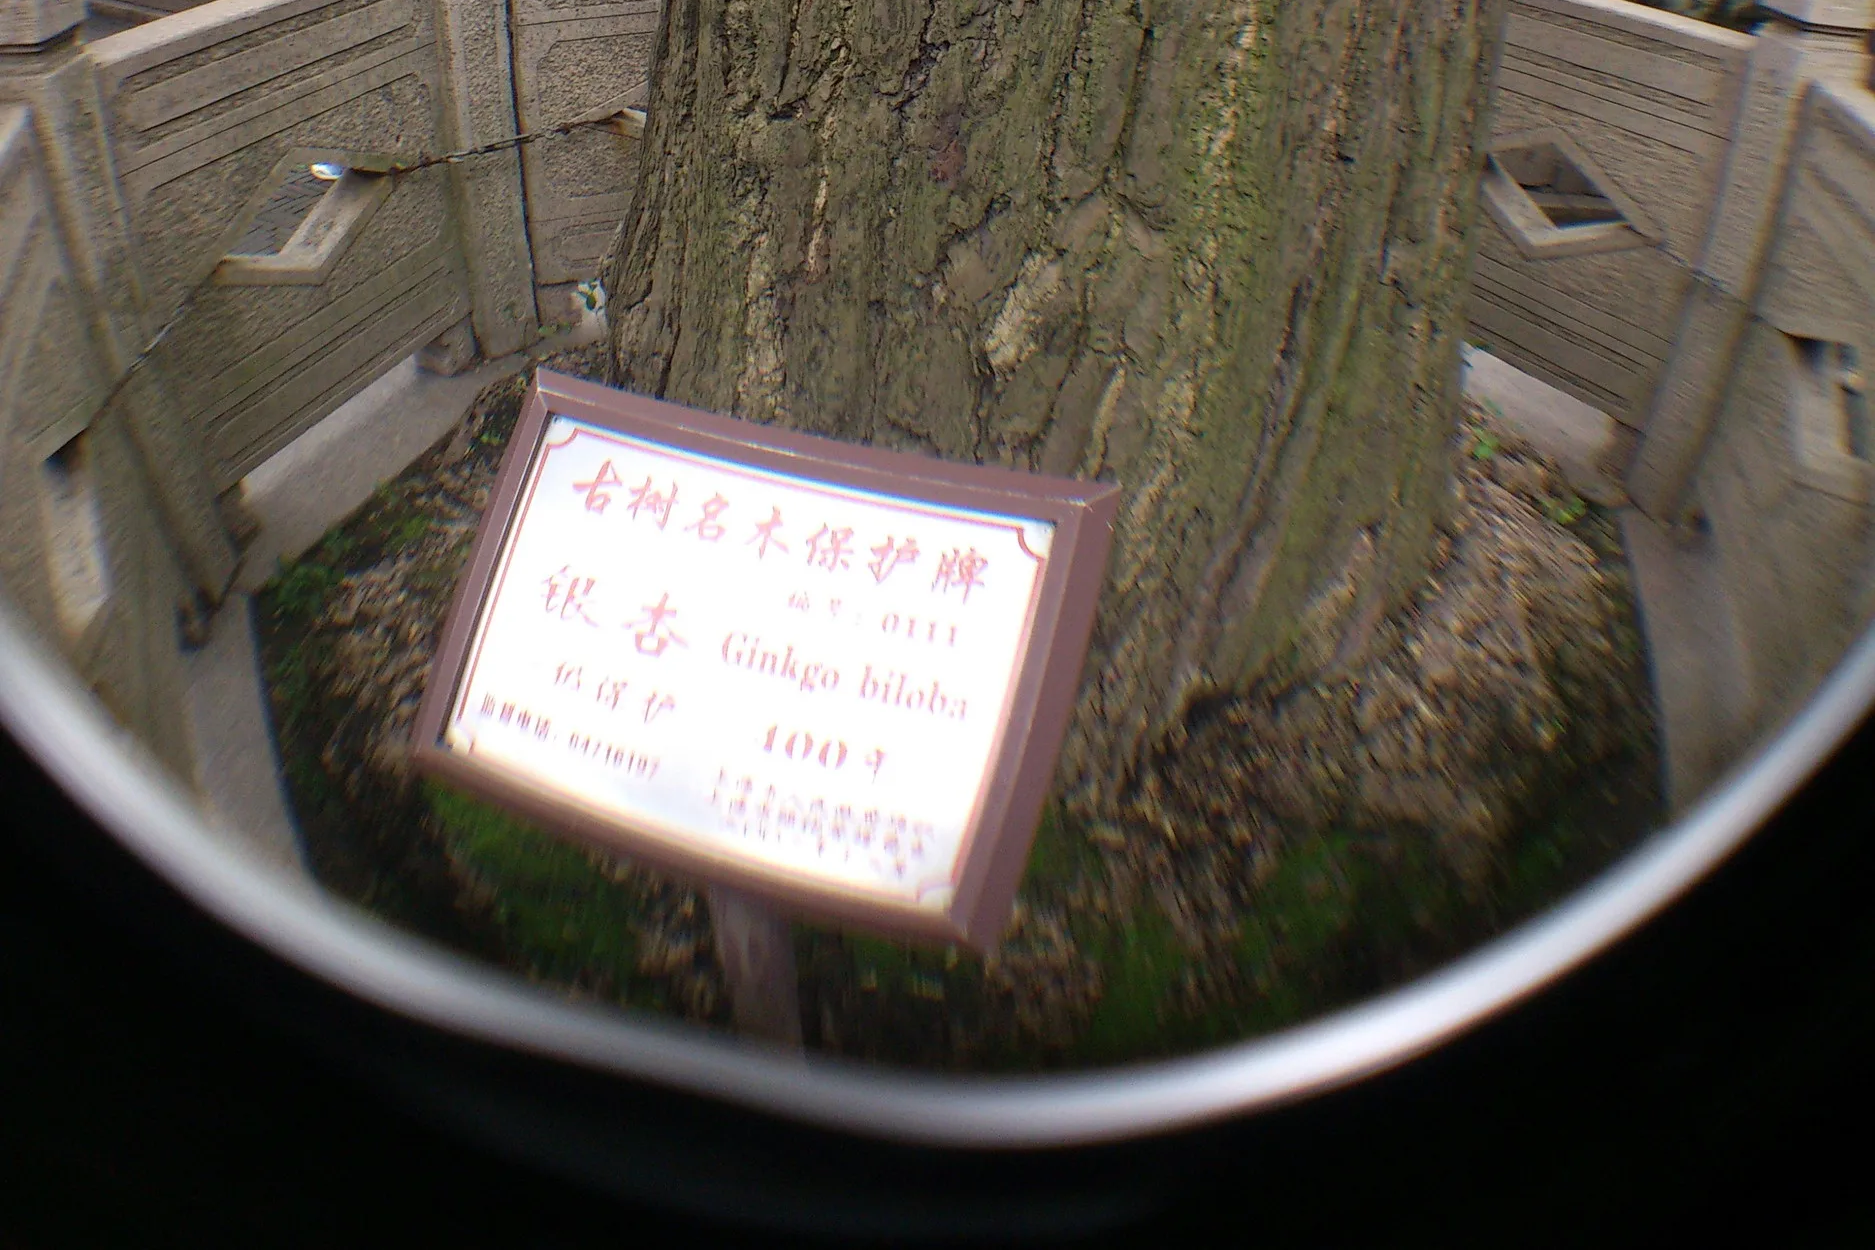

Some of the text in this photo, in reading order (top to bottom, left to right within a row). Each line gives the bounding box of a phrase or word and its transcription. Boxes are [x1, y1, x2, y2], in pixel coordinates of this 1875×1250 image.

[572, 459, 987, 604] 古树名木保护牌
[539, 563, 689, 658] 银杏
[720, 630, 968, 721] Ginkgo biloba
